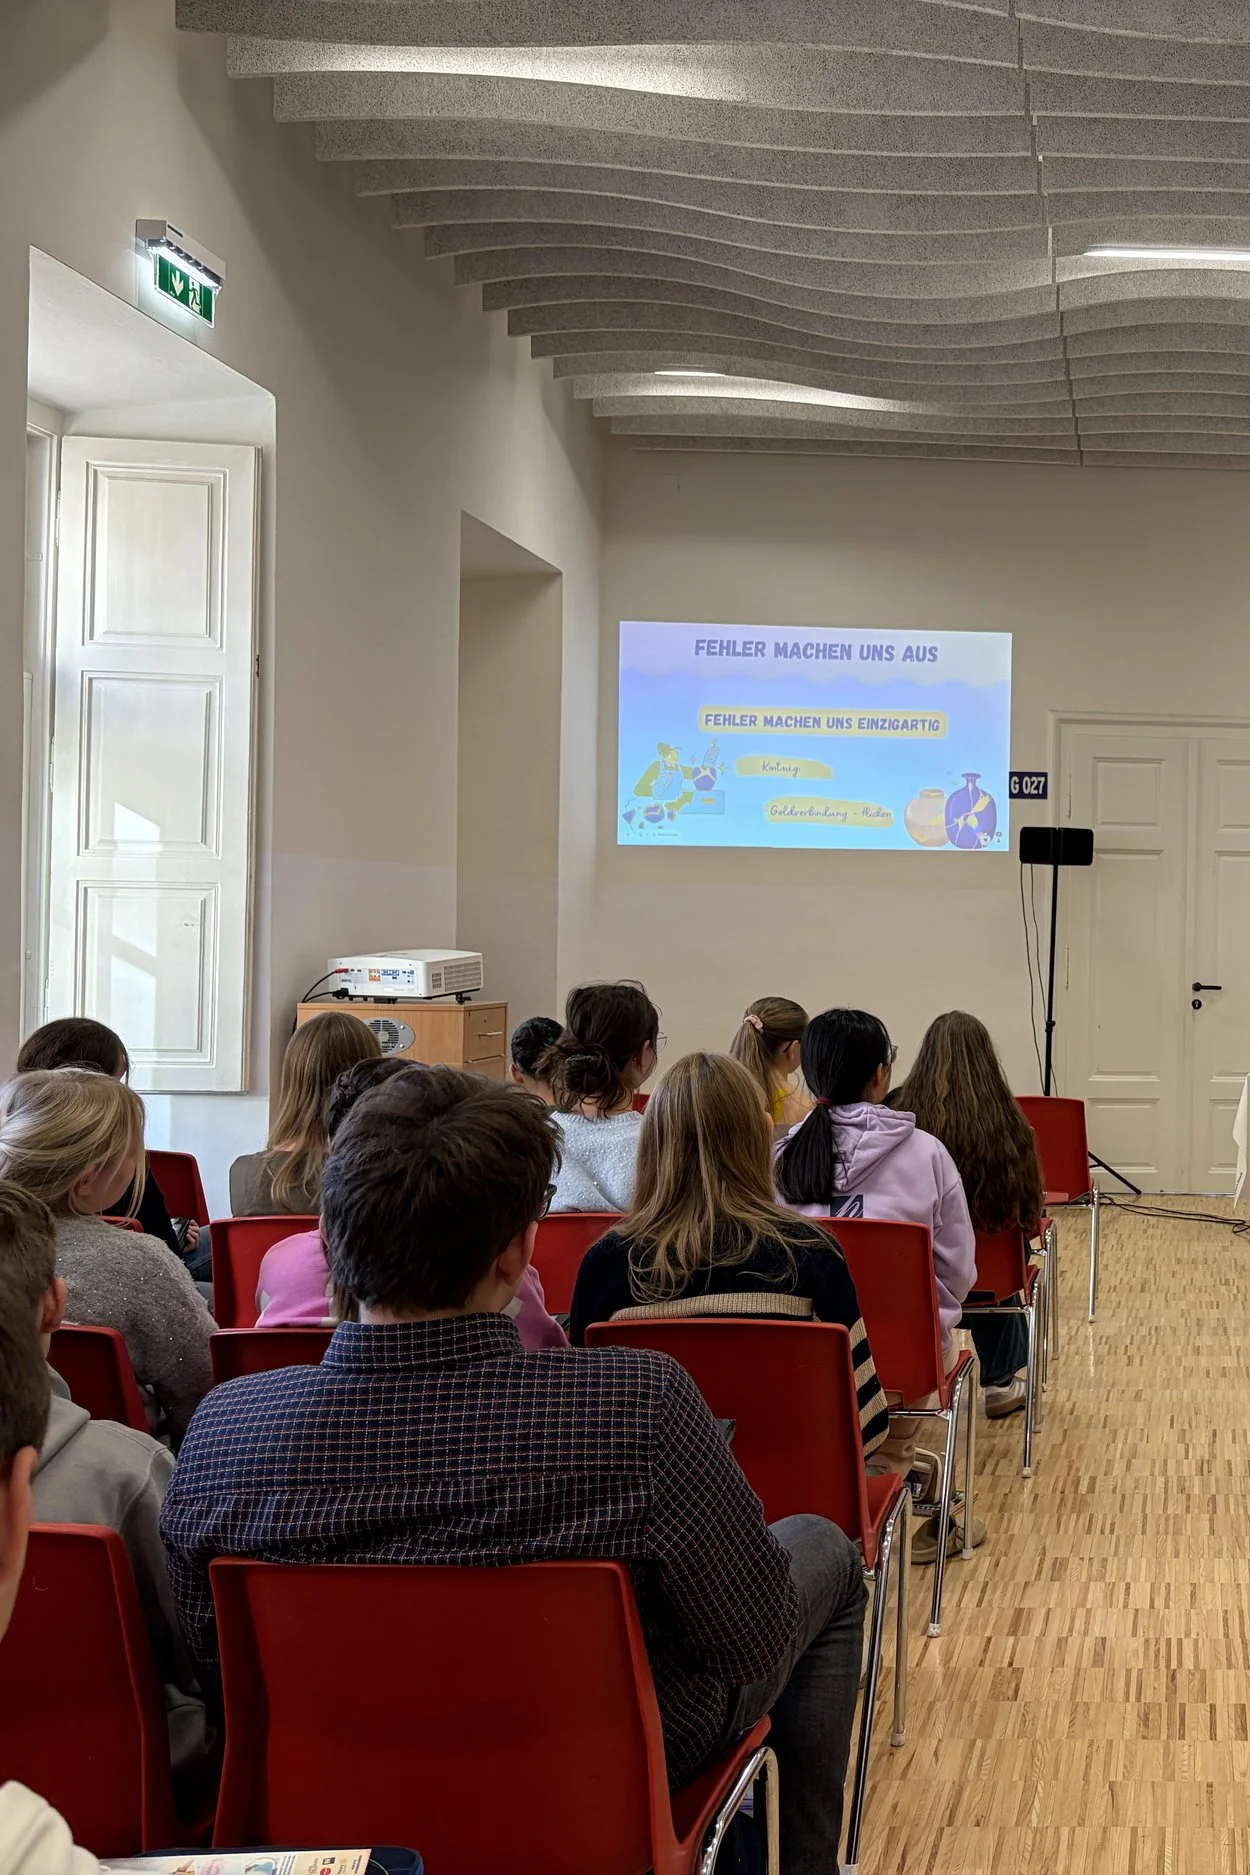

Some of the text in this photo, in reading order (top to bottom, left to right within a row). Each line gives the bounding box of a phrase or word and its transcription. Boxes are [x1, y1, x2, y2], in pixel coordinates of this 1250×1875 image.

[695, 639, 938, 662] FEHLER MACHEN UNS AUS
[704, 713, 940, 732] FEHLER MACHEN UNS EINZIGARTIG
[1011, 776, 1046, 794] G 027
